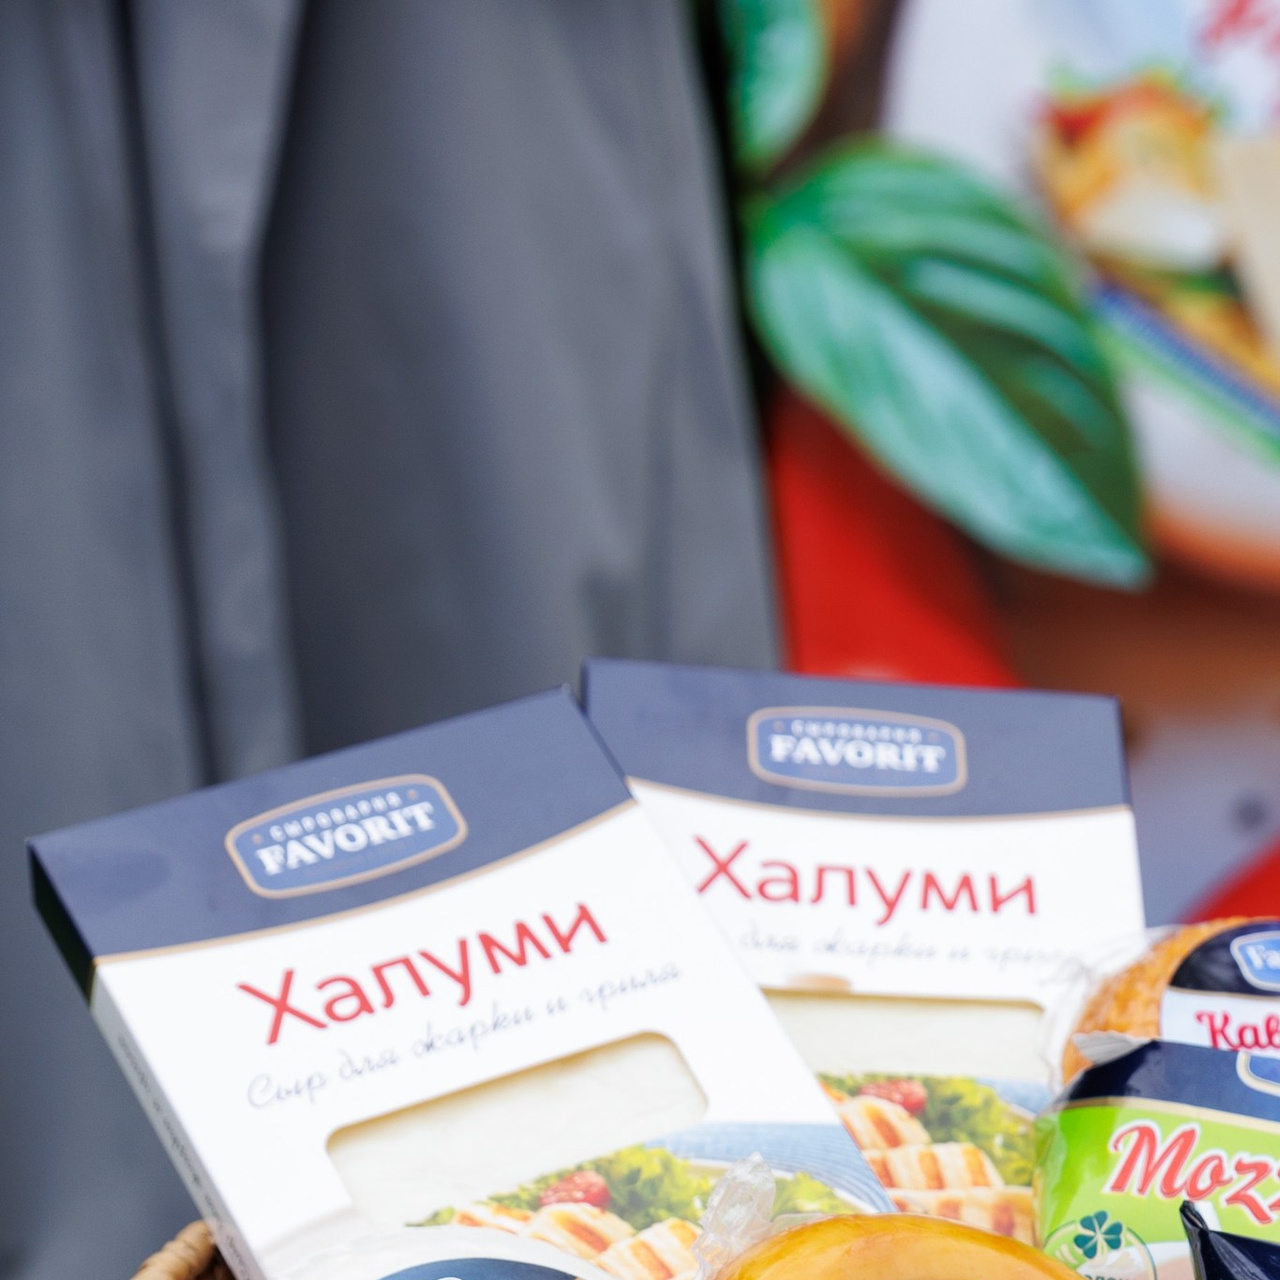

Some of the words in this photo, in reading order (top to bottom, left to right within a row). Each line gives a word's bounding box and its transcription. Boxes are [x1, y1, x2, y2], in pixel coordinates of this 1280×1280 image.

[767, 733, 947, 774] FAVORIT
[254, 800, 436, 876] FAVORIT
[694, 834, 1038, 927] Халуми
[237, 902, 608, 1045] Халуми
[246, 1071, 328, 1109] Сыр
